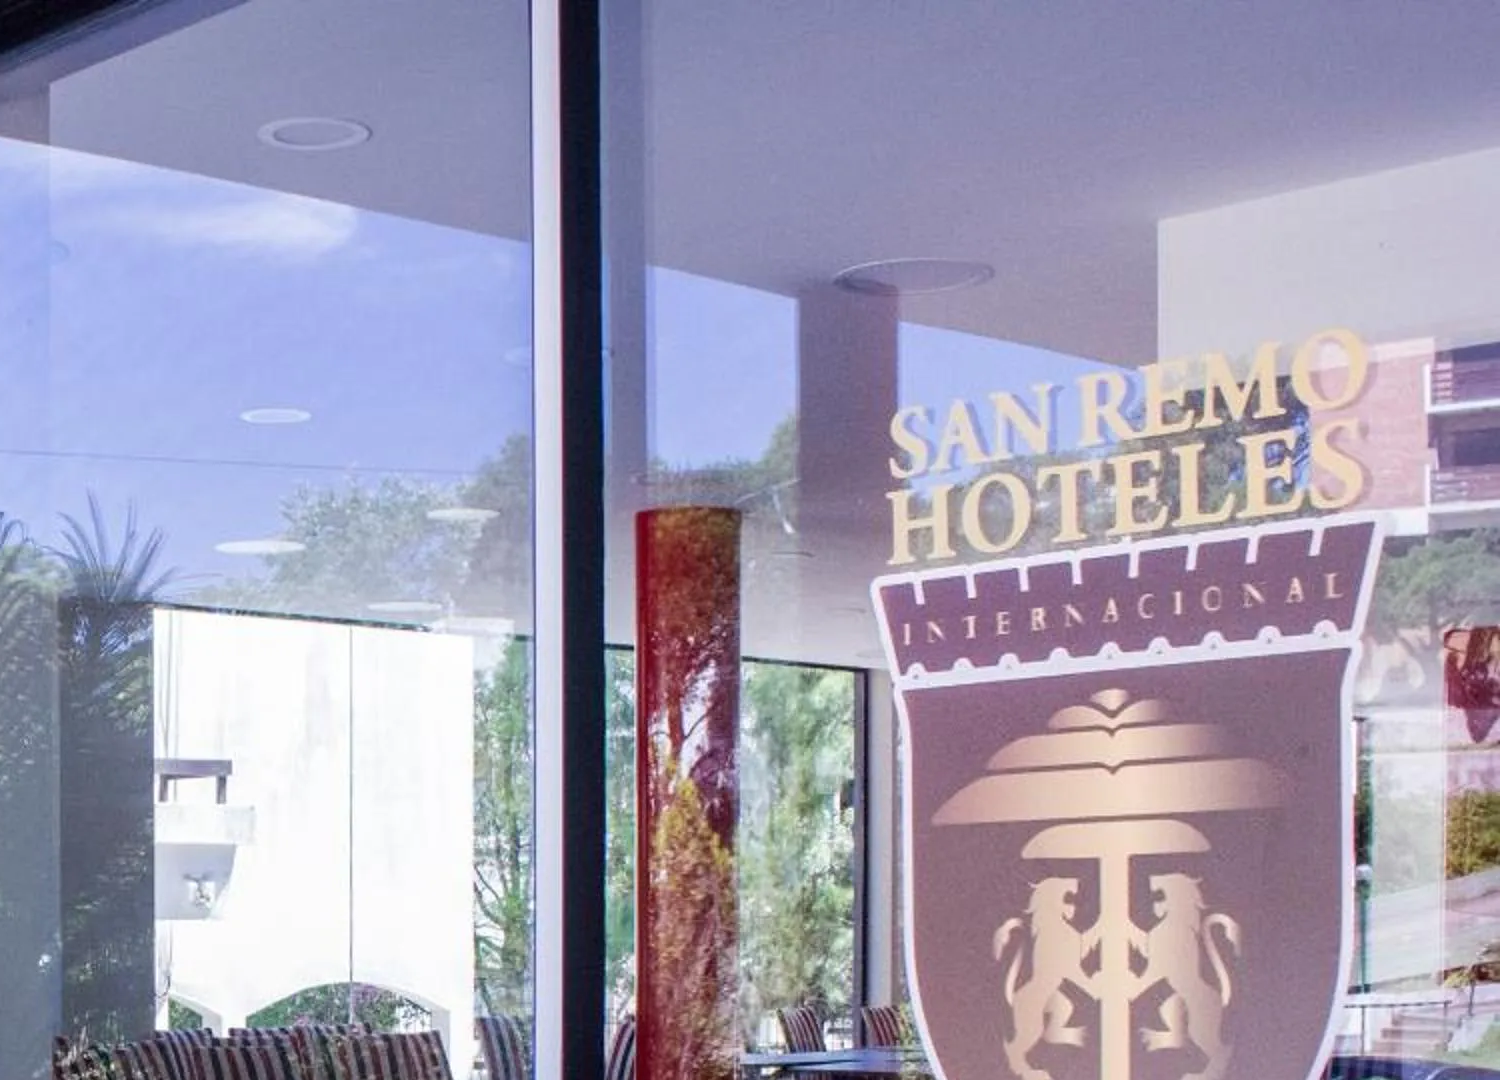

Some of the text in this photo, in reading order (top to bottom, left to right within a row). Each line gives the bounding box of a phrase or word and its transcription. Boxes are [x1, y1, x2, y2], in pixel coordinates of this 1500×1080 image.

[889, 328, 1368, 480] SAN REMO
[887, 417, 1365, 565] HOTELES
[903, 572, 1344, 646] INTERNACIONAL
